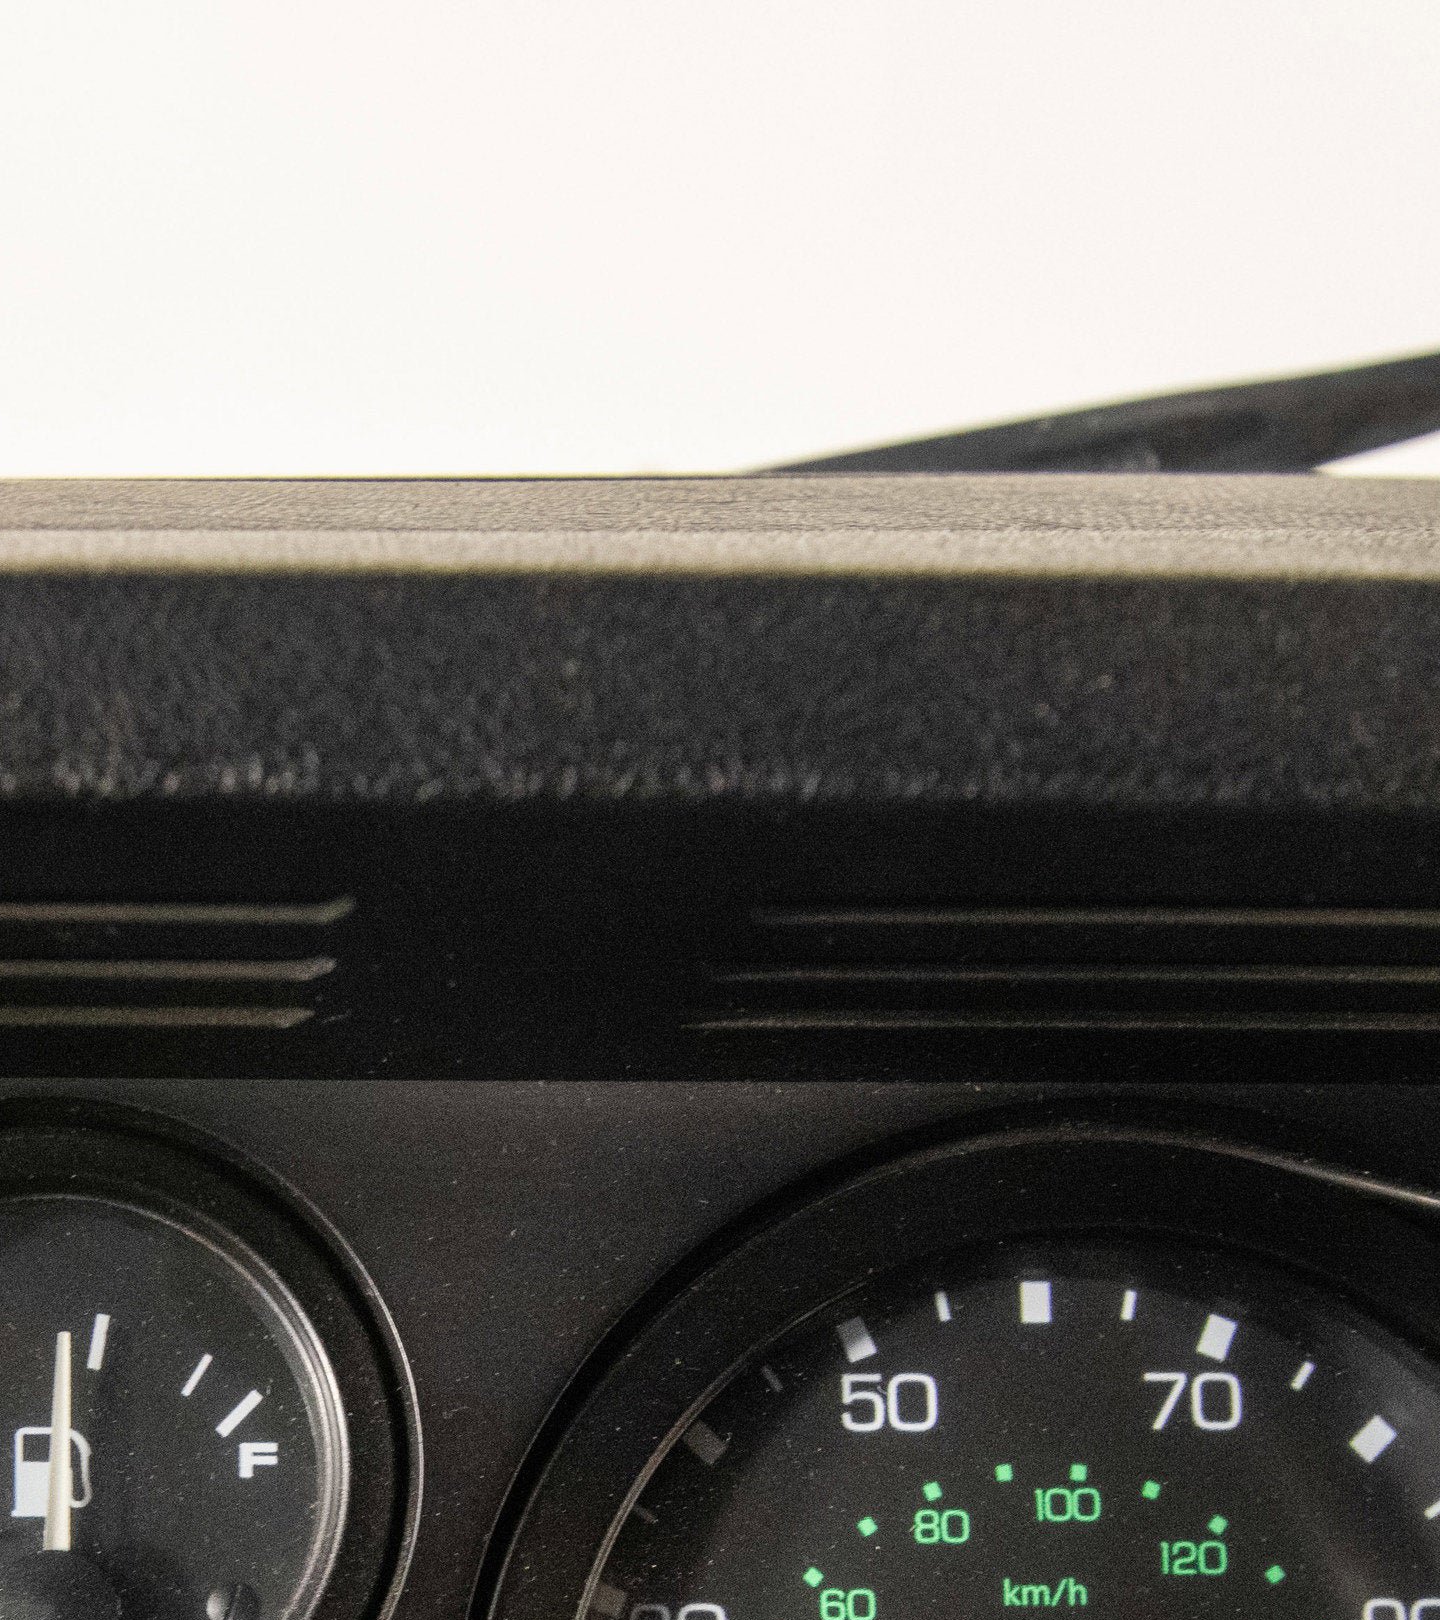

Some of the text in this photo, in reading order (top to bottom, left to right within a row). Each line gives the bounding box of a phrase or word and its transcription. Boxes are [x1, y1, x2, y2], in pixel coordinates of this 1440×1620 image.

[838, 1372, 939, 1432] 50
[1141, 1372, 1244, 1430] 70
[238, 1442, 279, 1479] F
[1033, 1487, 1101, 1523] 100
[912, 1508, 971, 1546] 80
[1160, 1541, 1228, 1577] 120
[1002, 1579, 1089, 1608] km/h
